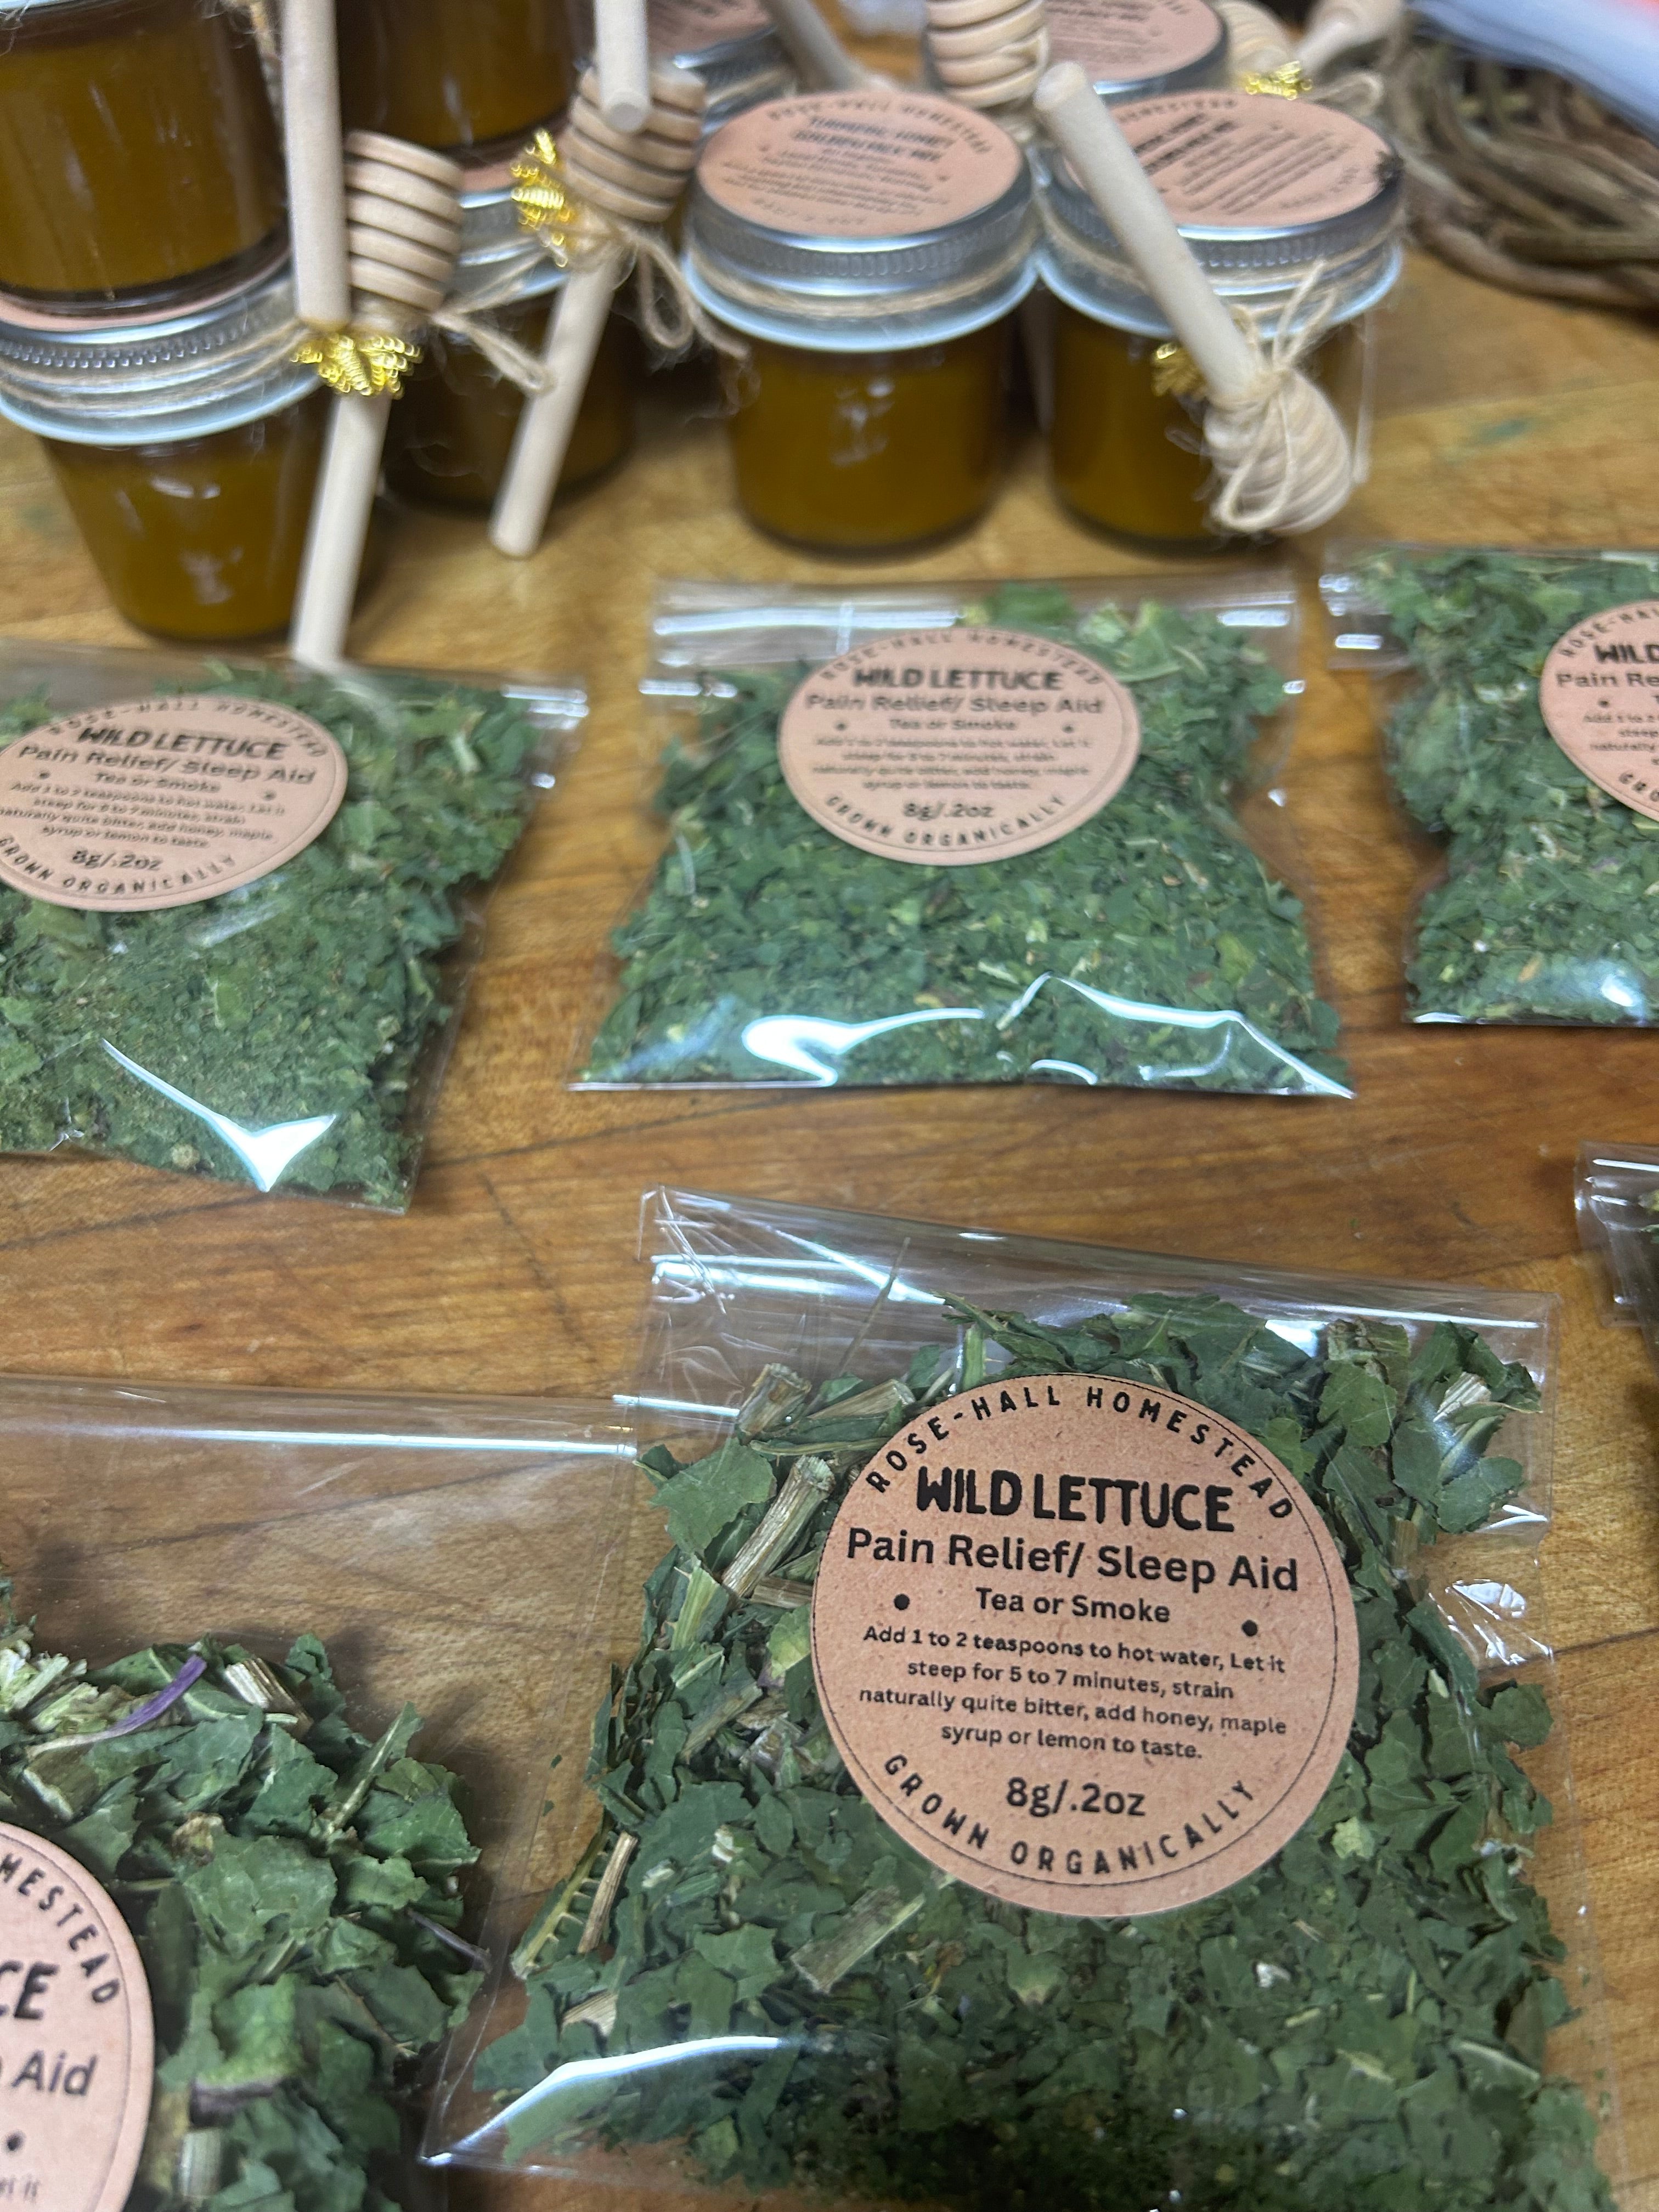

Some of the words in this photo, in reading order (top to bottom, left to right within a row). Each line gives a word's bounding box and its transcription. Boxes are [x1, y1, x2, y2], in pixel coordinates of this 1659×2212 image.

[853, 668, 923, 688] WILD
[929, 669, 1063, 691] LETTUCE
[1556, 672, 1620, 687] Pain
[806, 694, 865, 709] Pain
[872, 696, 963, 713] Relief/
[970, 698, 1049, 716] Sleep
[1055, 698, 1104, 714] Aid
[77, 727, 153, 747] WILD
[154, 733, 289, 760] LETTUCE
[19, 745, 79, 763] Pain
[86, 749, 178, 772] Relief/
[180, 759, 260, 782] Sleep
[263, 763, 317, 785] Aid
[866, 1385, 1060, 1493] ROSE-HALL
[1087, 1385, 1293, 1520] HOMESTEAD
[916, 1466, 1022, 1516] WILD
[1034, 1474, 1234, 1533] LETTUCE
[847, 1527, 934, 1565] Pain
[949, 1533, 1085, 1578] Relief/
[1097, 1544, 1215, 1593] Sleep
[1228, 1555, 1299, 1592] Aid
[975, 1587, 1024, 1612] Tea
[1034, 1598, 1065, 1616] or
[1072, 1595, 1171, 1623] Smoke
[864, 1626, 906, 1643] Add
[911, 1628, 921, 1644] 1
[928, 1630, 950, 1647] to
[956, 1632, 967, 1647] 2
[973, 1633, 1084, 1655] teaspoons
[1090, 1642, 1112, 1659] to
[1118, 1643, 1154, 1662] hot
[1159, 1649, 1224, 1671] water,
[1229, 1653, 1265, 1671] Let
[1270, 1656, 1285, 1673] it
[907, 1662, 966, 1683] steep
[972, 1663, 1003, 1680] for
[1009, 1666, 1022, 1681] 5
[1028, 1668, 1049, 1684] to
[1055, 1669, 1066, 1685] 7
[1073, 1671, 1166, 1697] minutes,
[1172, 1680, 1233, 1699] strain
[860, 1687, 955, 1713] naturally
[961, 1696, 1017, 1717] quite
[1024, 1699, 1090, 1720] bitter,
[1096, 1704, 1135, 1723] add
[1142, 1706, 1214, 1731] honey,
[1220, 1716, 1286, 1737] maple
[942, 1725, 1002, 1746] syrup
[1009, 1730, 1032, 1745] or
[1037, 1729, 1106, 1751] lemon
[1112, 1736, 1135, 1753] to
[1141, 1739, 1203, 1758] taste.
[885, 1754, 988, 1849] GROWN
[1011, 1780, 1255, 1874] ORGANICALLY
[1006, 1777, 1146, 1818] 8g/.2oz
[11, 2049, 98, 2097] Aid
